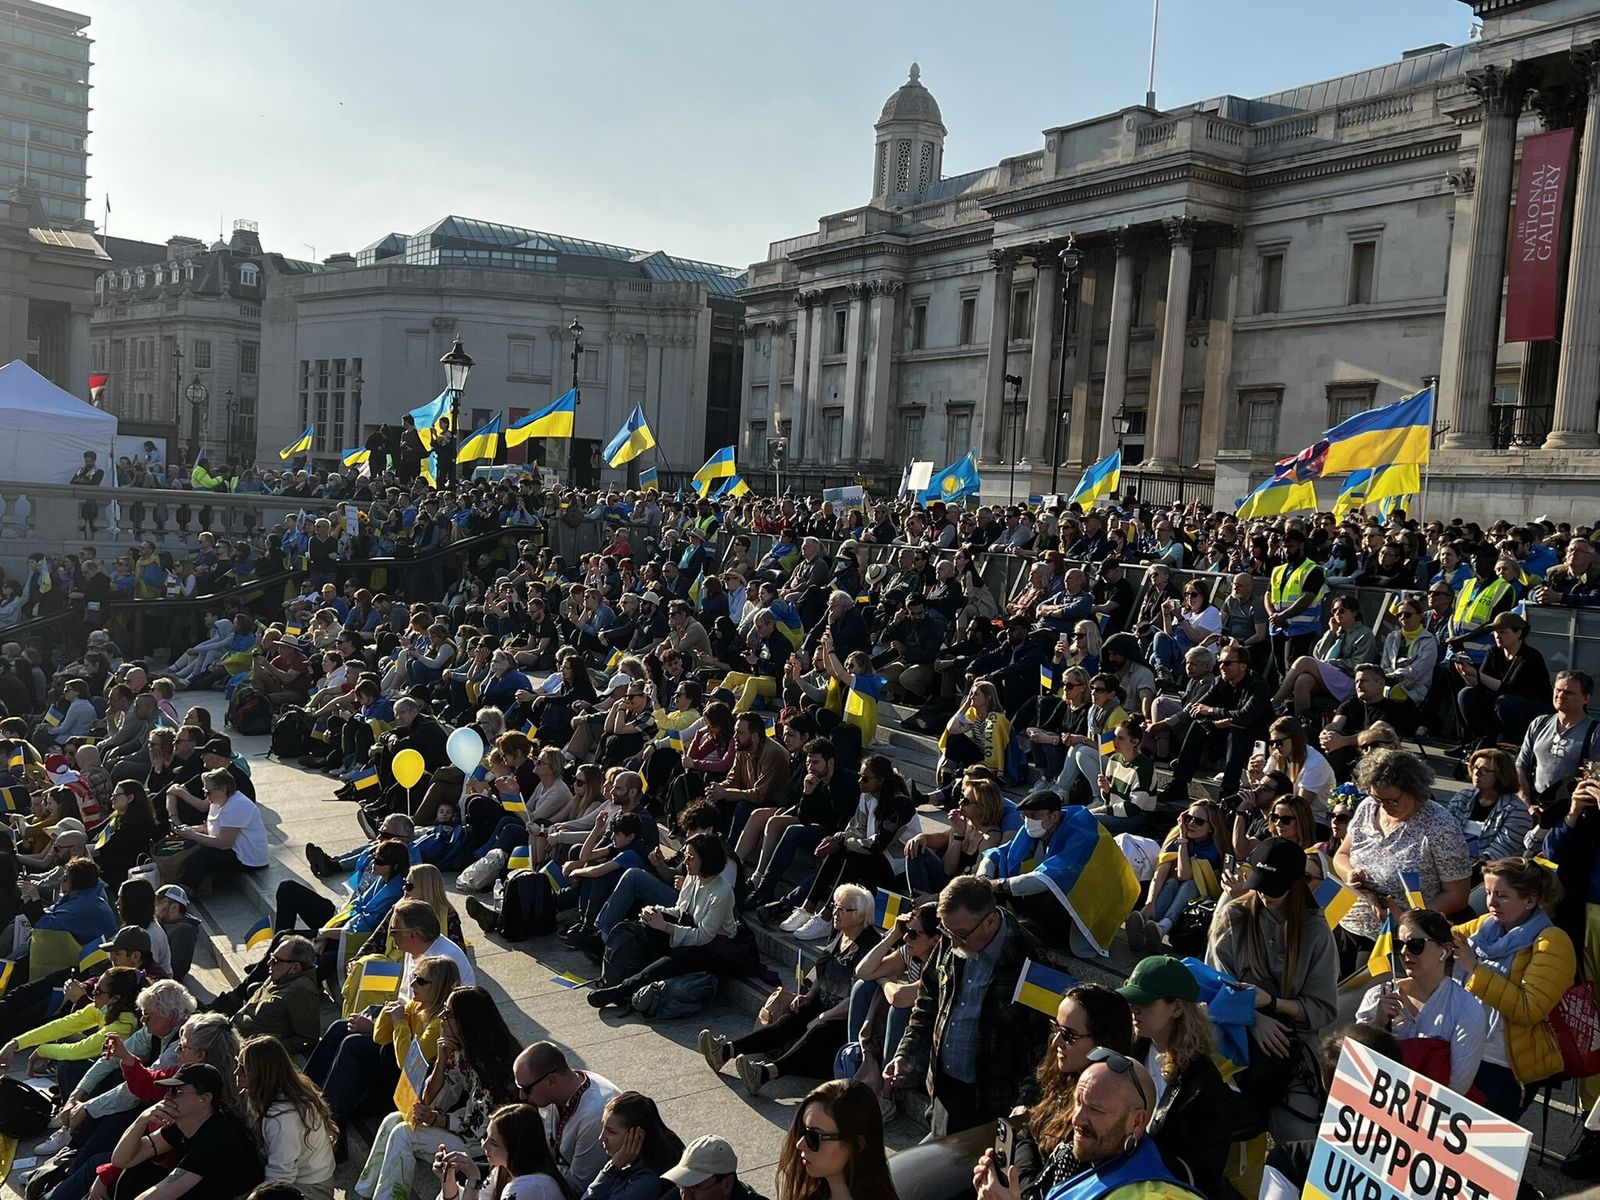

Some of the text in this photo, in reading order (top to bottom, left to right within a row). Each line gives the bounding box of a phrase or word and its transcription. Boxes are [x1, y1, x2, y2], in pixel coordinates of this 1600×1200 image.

[1523, 164, 1547, 262] NATIONAL
[1537, 163, 1562, 261] GALLERY
[1369, 1068, 1472, 1155] BRITS
[1324, 1151, 1400, 1200] UKR
